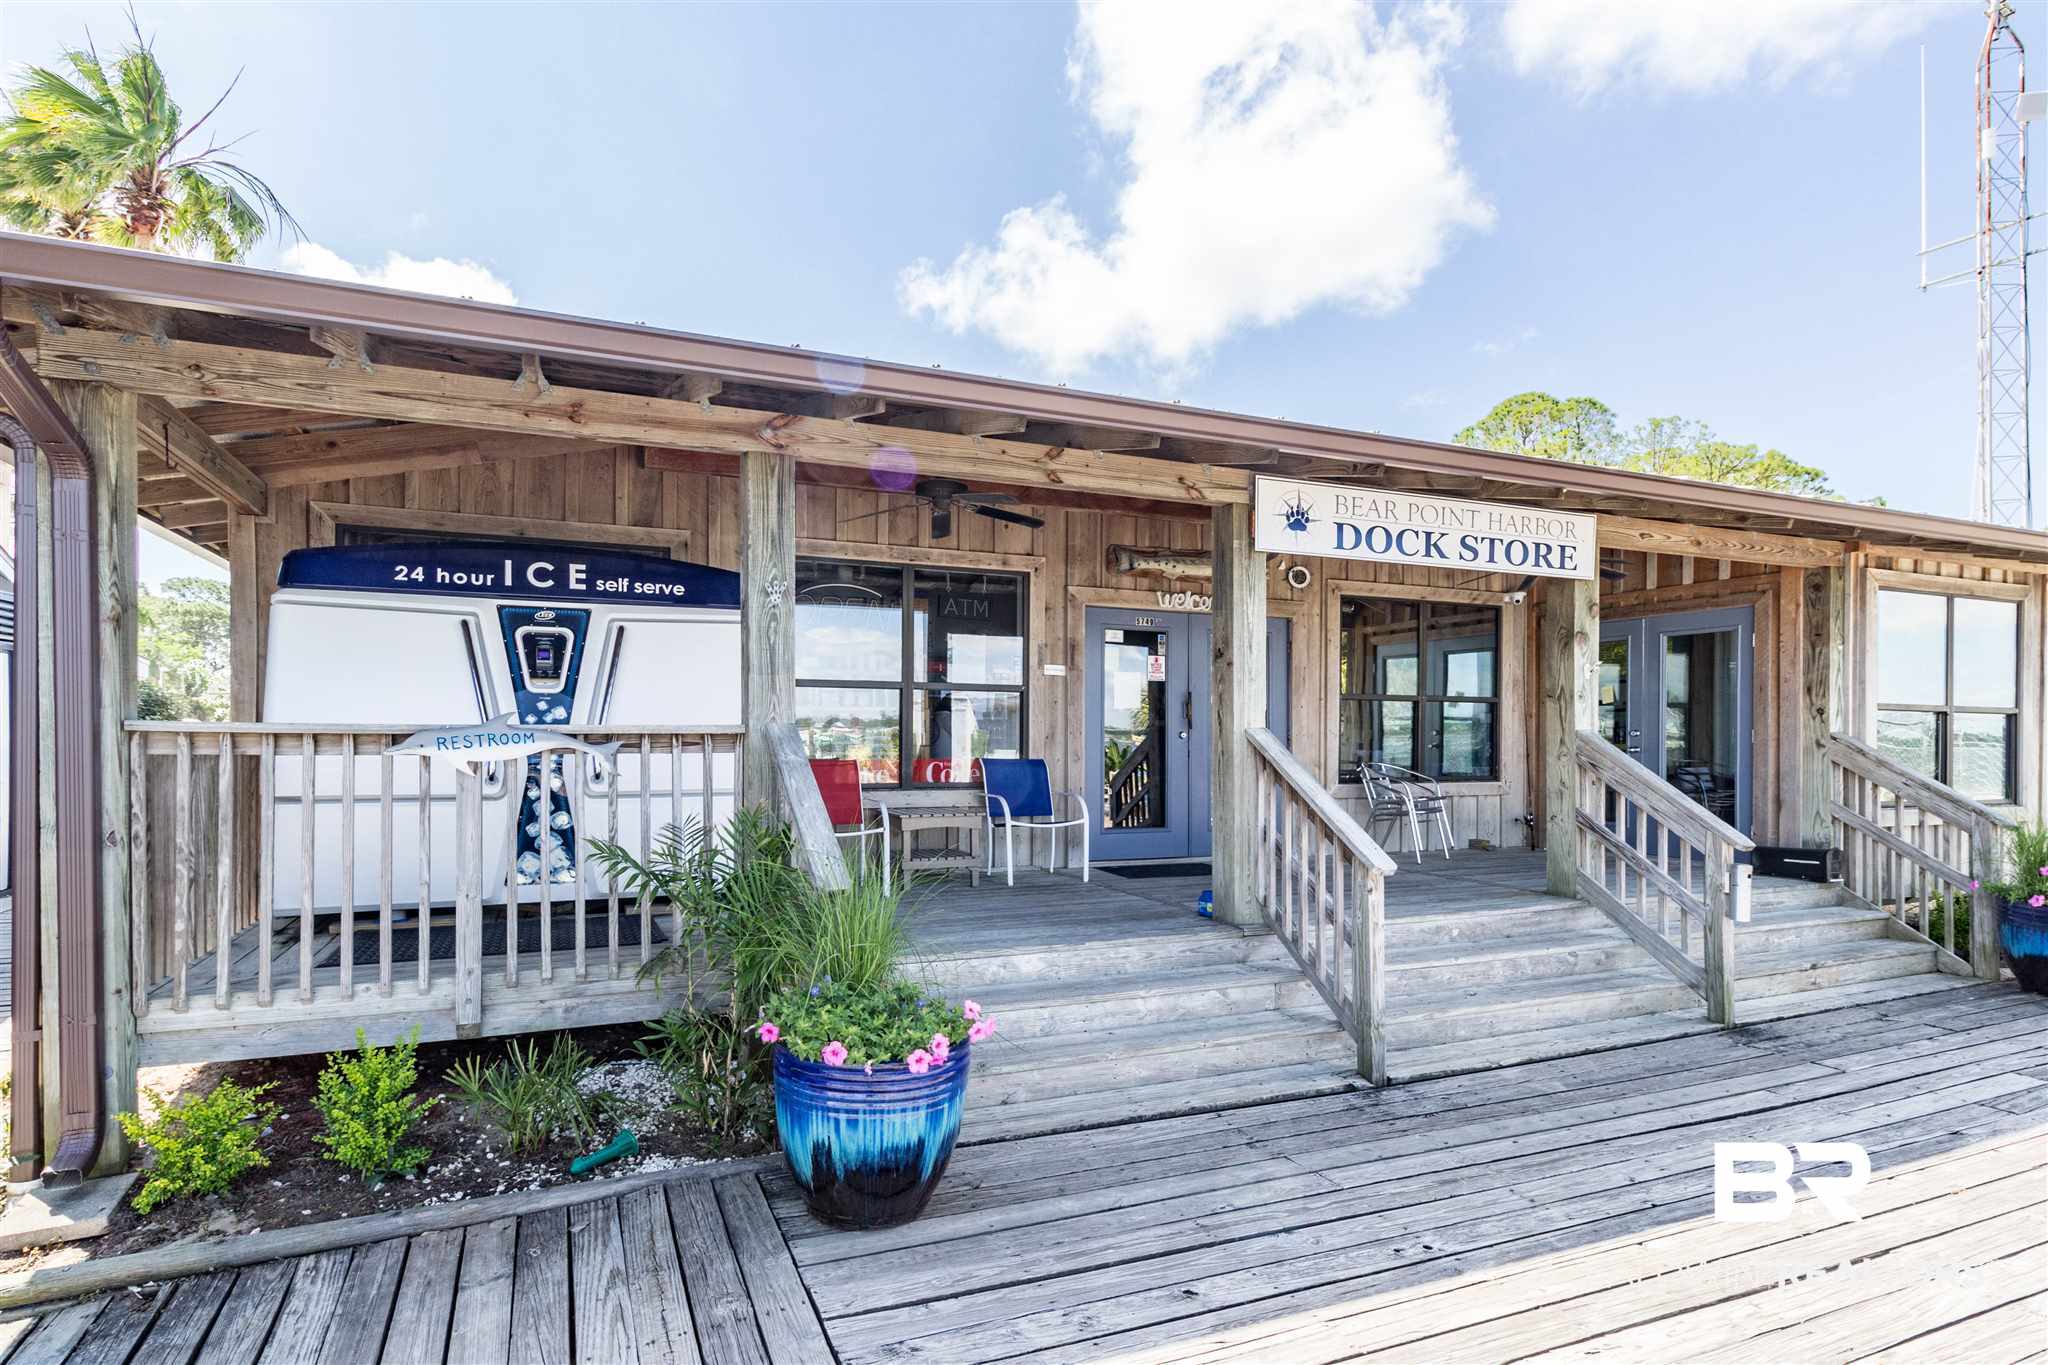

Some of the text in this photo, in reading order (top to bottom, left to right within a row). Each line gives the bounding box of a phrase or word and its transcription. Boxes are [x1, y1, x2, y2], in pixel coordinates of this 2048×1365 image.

[1334, 494, 1577, 539] BEAR POINT HARBOR
[1333, 521, 1578, 571] DOCK STORE
[394, 559, 686, 596] 24 hour ICE self serve
[944, 598, 990, 618] ATM
[1157, 590, 1213, 611] welco
[436, 732, 536, 751] RESTROOM
[926, 760, 980, 784] Coe
